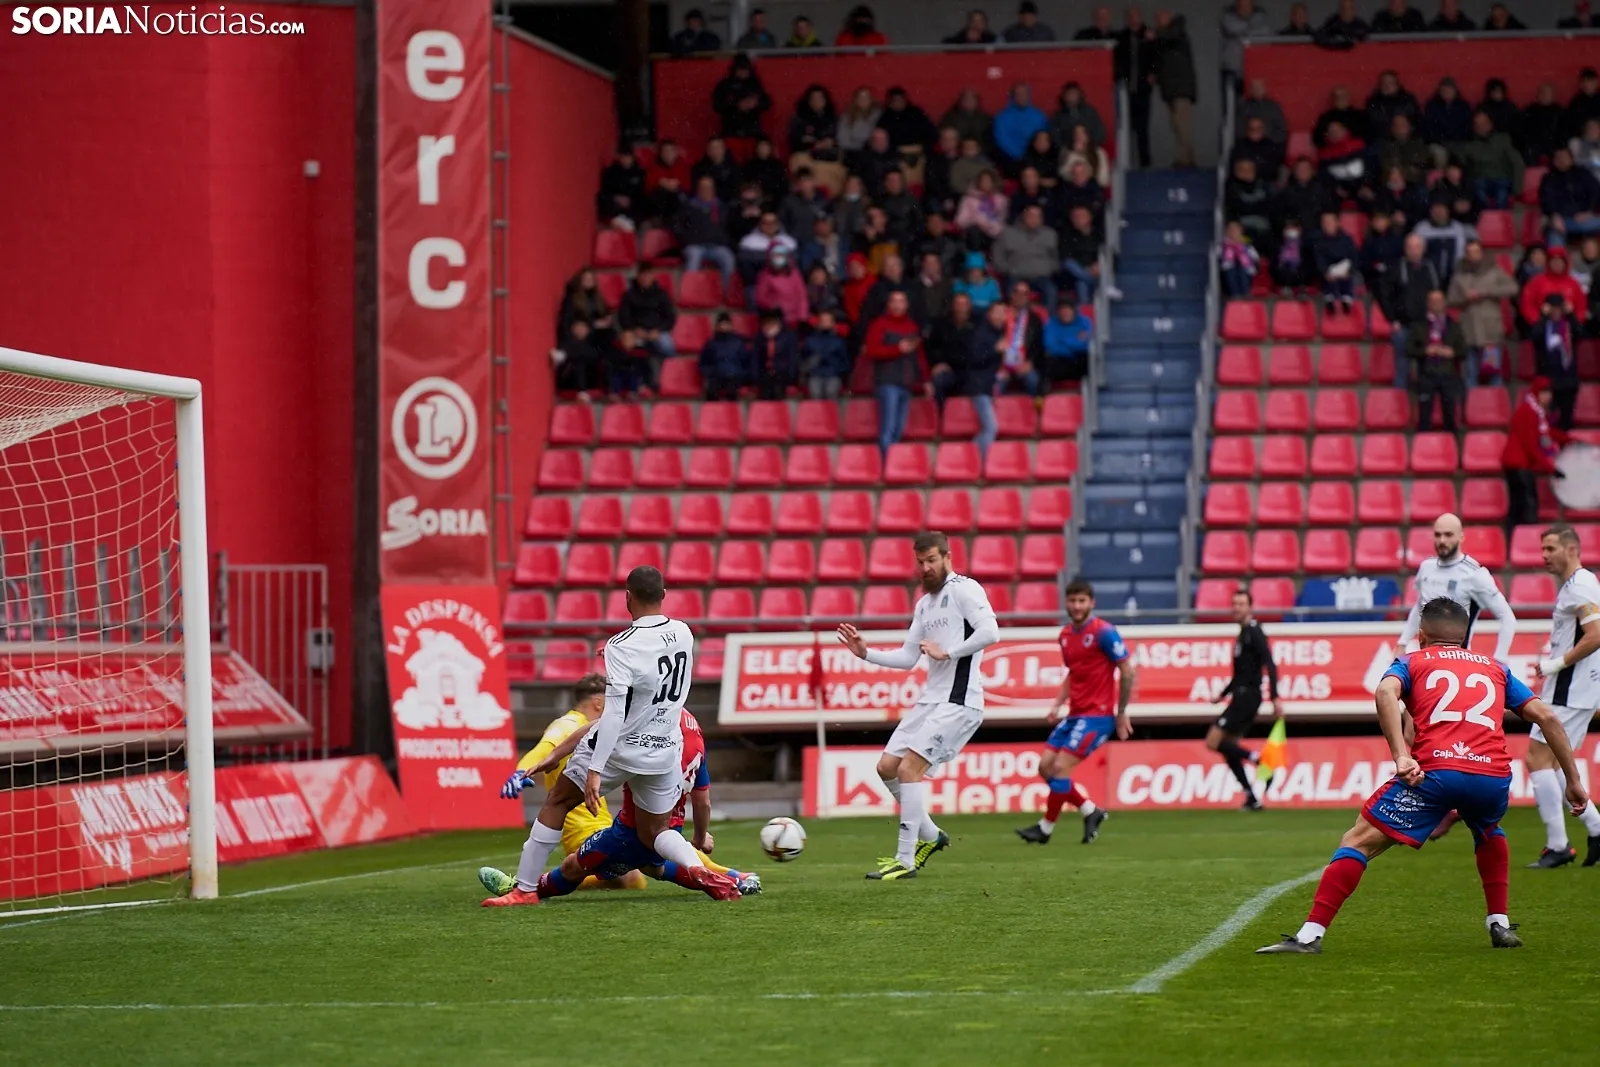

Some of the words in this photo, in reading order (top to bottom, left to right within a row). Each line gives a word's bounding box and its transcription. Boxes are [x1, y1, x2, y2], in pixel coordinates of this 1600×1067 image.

[405, 599, 504, 659] DESPENSA
[1130, 640, 1333, 668] ASCENRES
[1438, 651, 1491, 666] BARROS
[652, 651, 687, 705] 20
[1189, 673, 1332, 702] ANNAS
[1425, 669, 1496, 731] 22
[1433, 749, 1454, 759] Caja
[1467, 752, 1492, 763] Soria
[922, 779, 1090, 814] Herc
